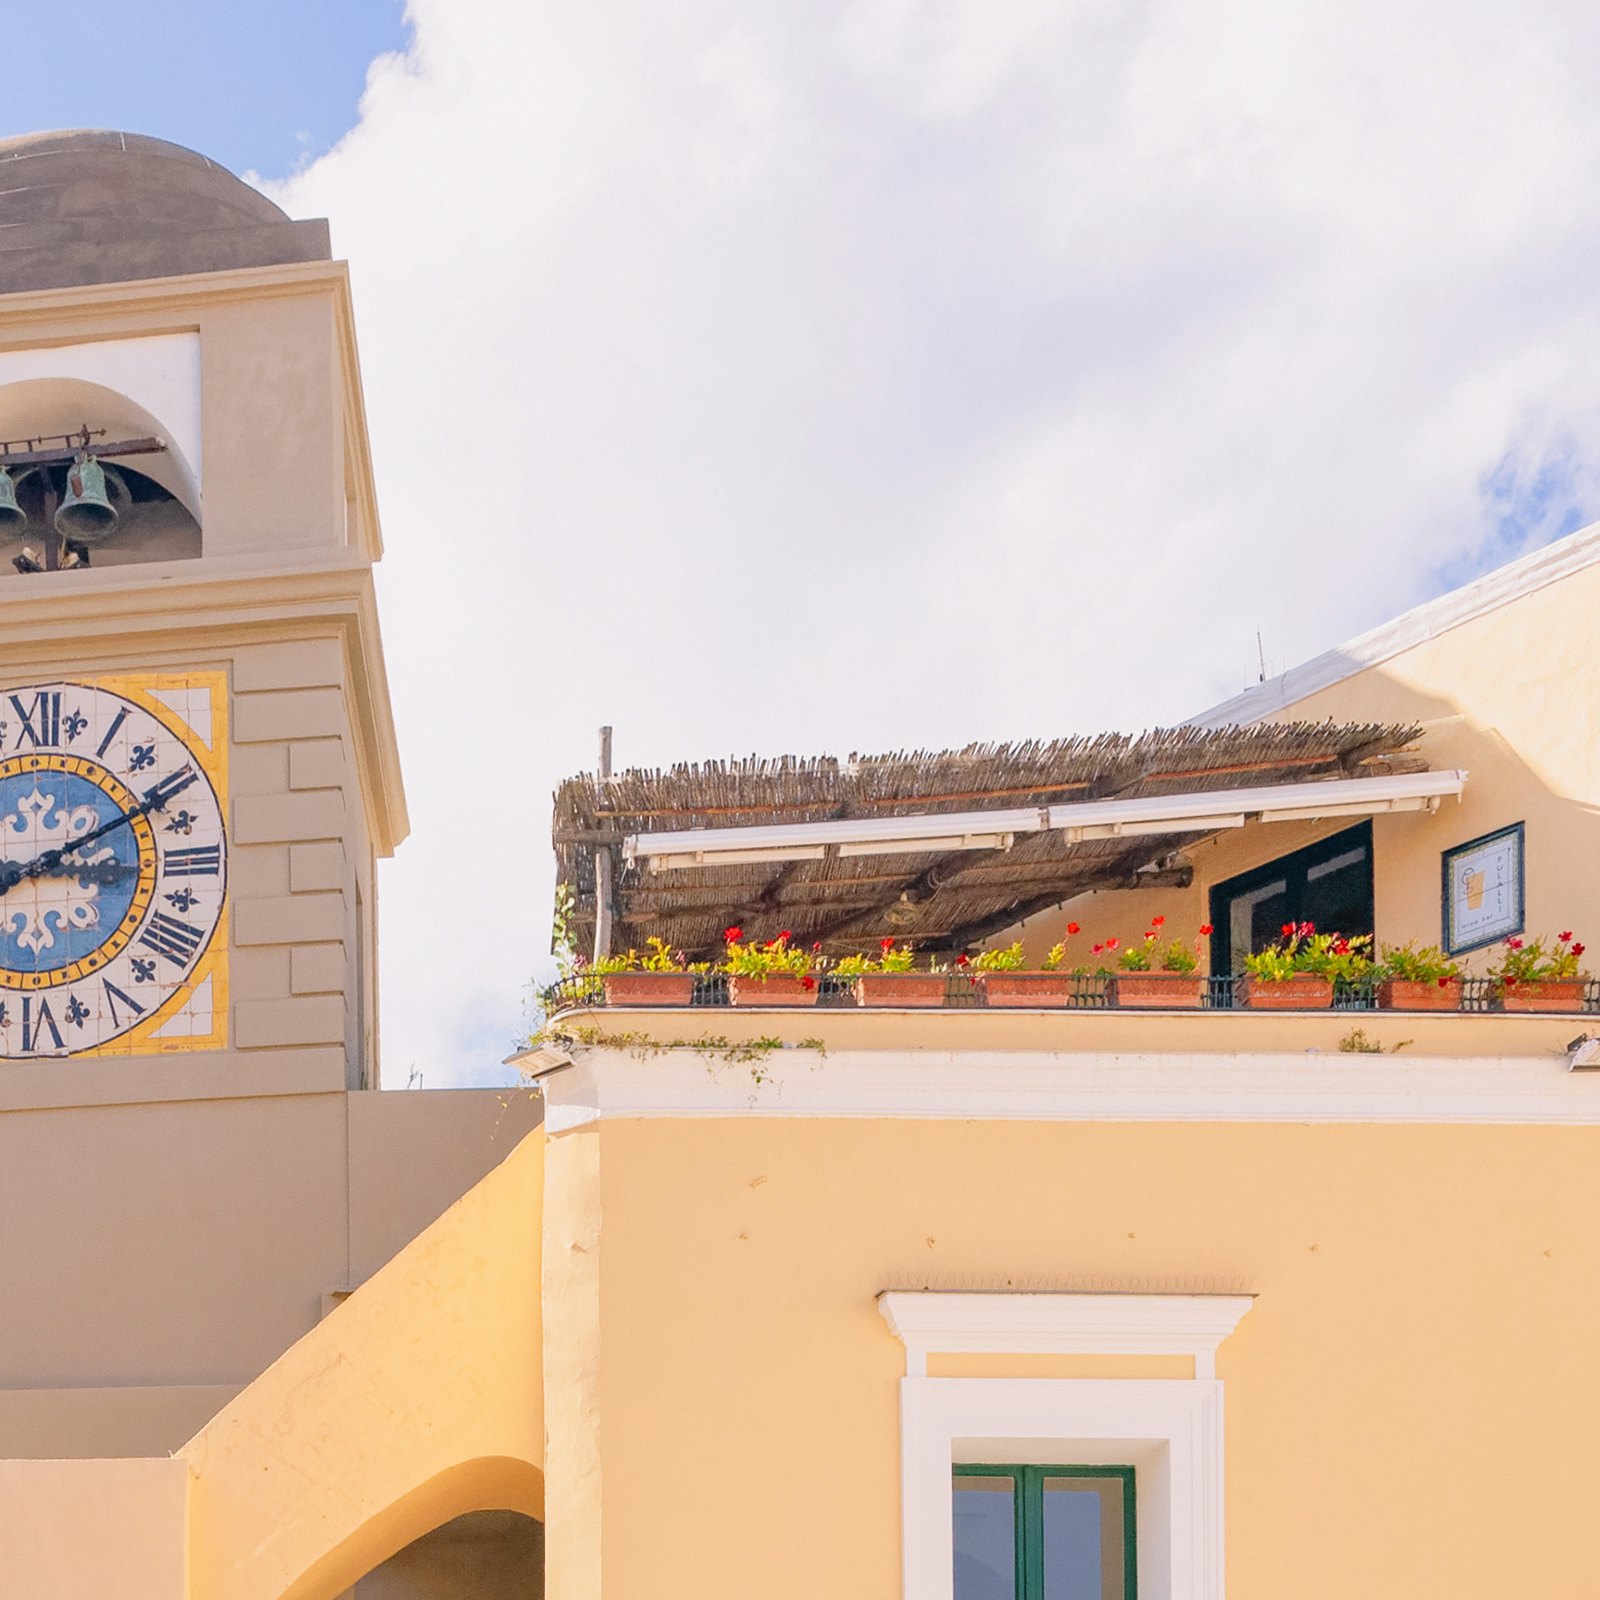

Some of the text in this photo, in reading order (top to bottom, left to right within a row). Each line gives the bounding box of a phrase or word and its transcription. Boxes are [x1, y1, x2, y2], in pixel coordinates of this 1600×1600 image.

[9, 691, 61, 750] XII
[95, 706, 134, 759] I
[163, 843, 220, 878] III
[139, 912, 206, 970] IIII
[20, 996, 69, 1052] VI
[102, 976, 147, 1030] V
